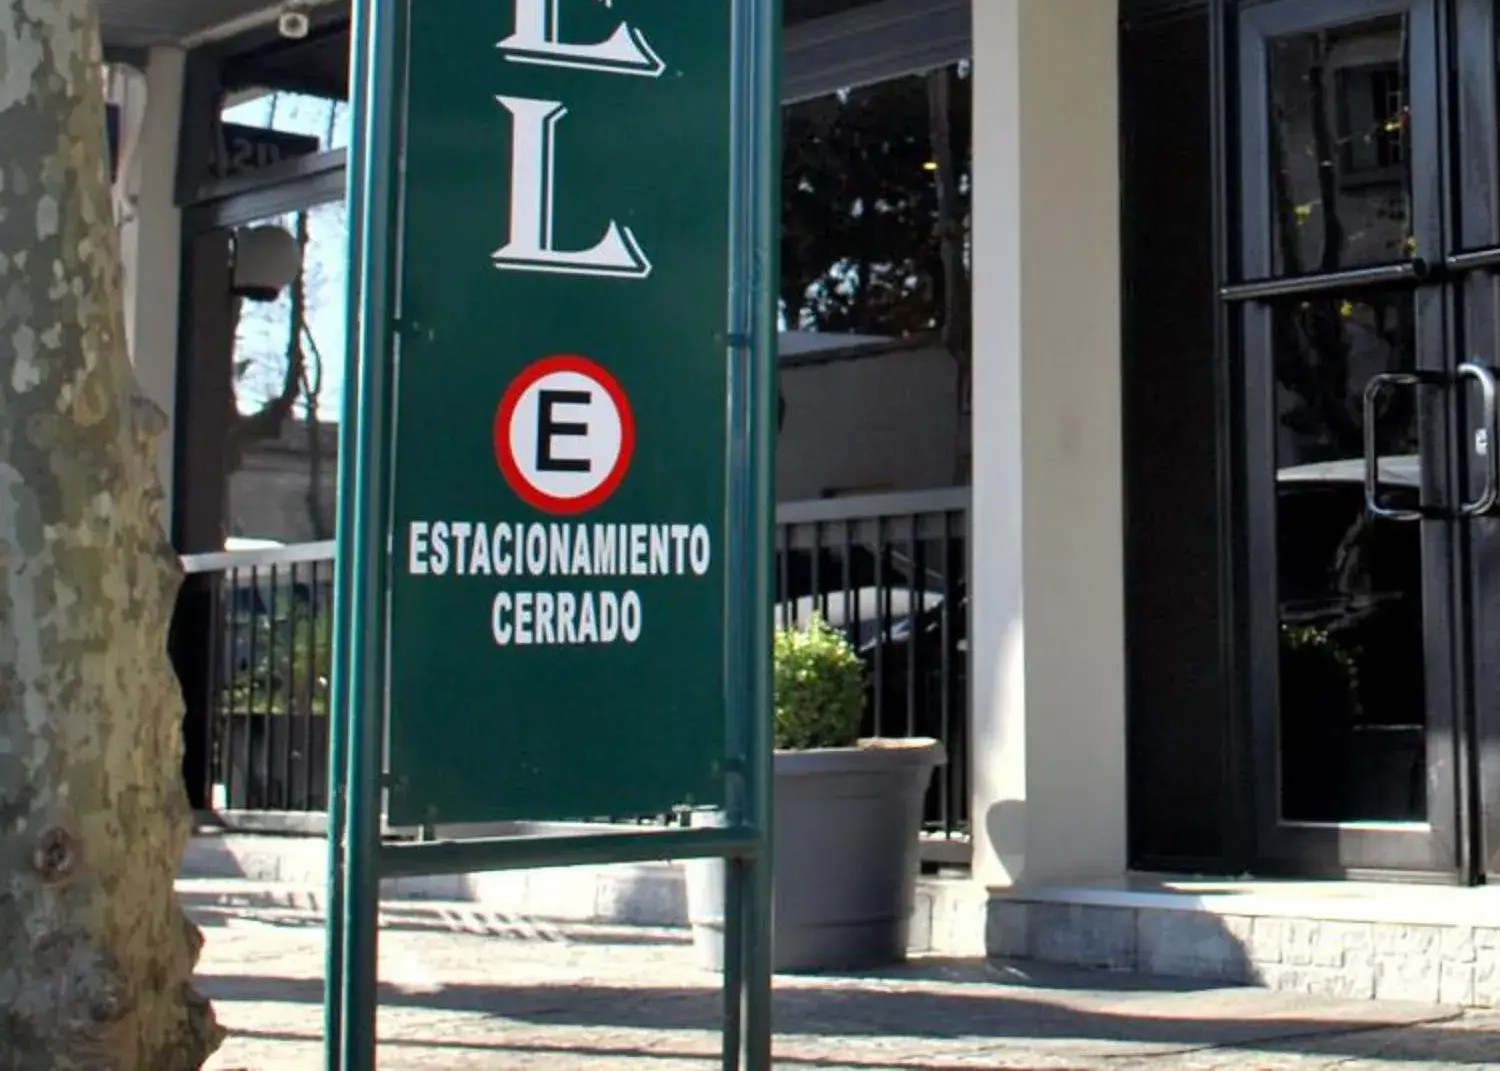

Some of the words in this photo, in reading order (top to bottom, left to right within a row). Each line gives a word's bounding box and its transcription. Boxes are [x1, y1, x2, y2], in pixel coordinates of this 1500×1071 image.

[535, 389, 592, 473] E
[408, 520, 712, 577] ESTACIONAMIENTO
[491, 589, 643, 646] CERRADO
